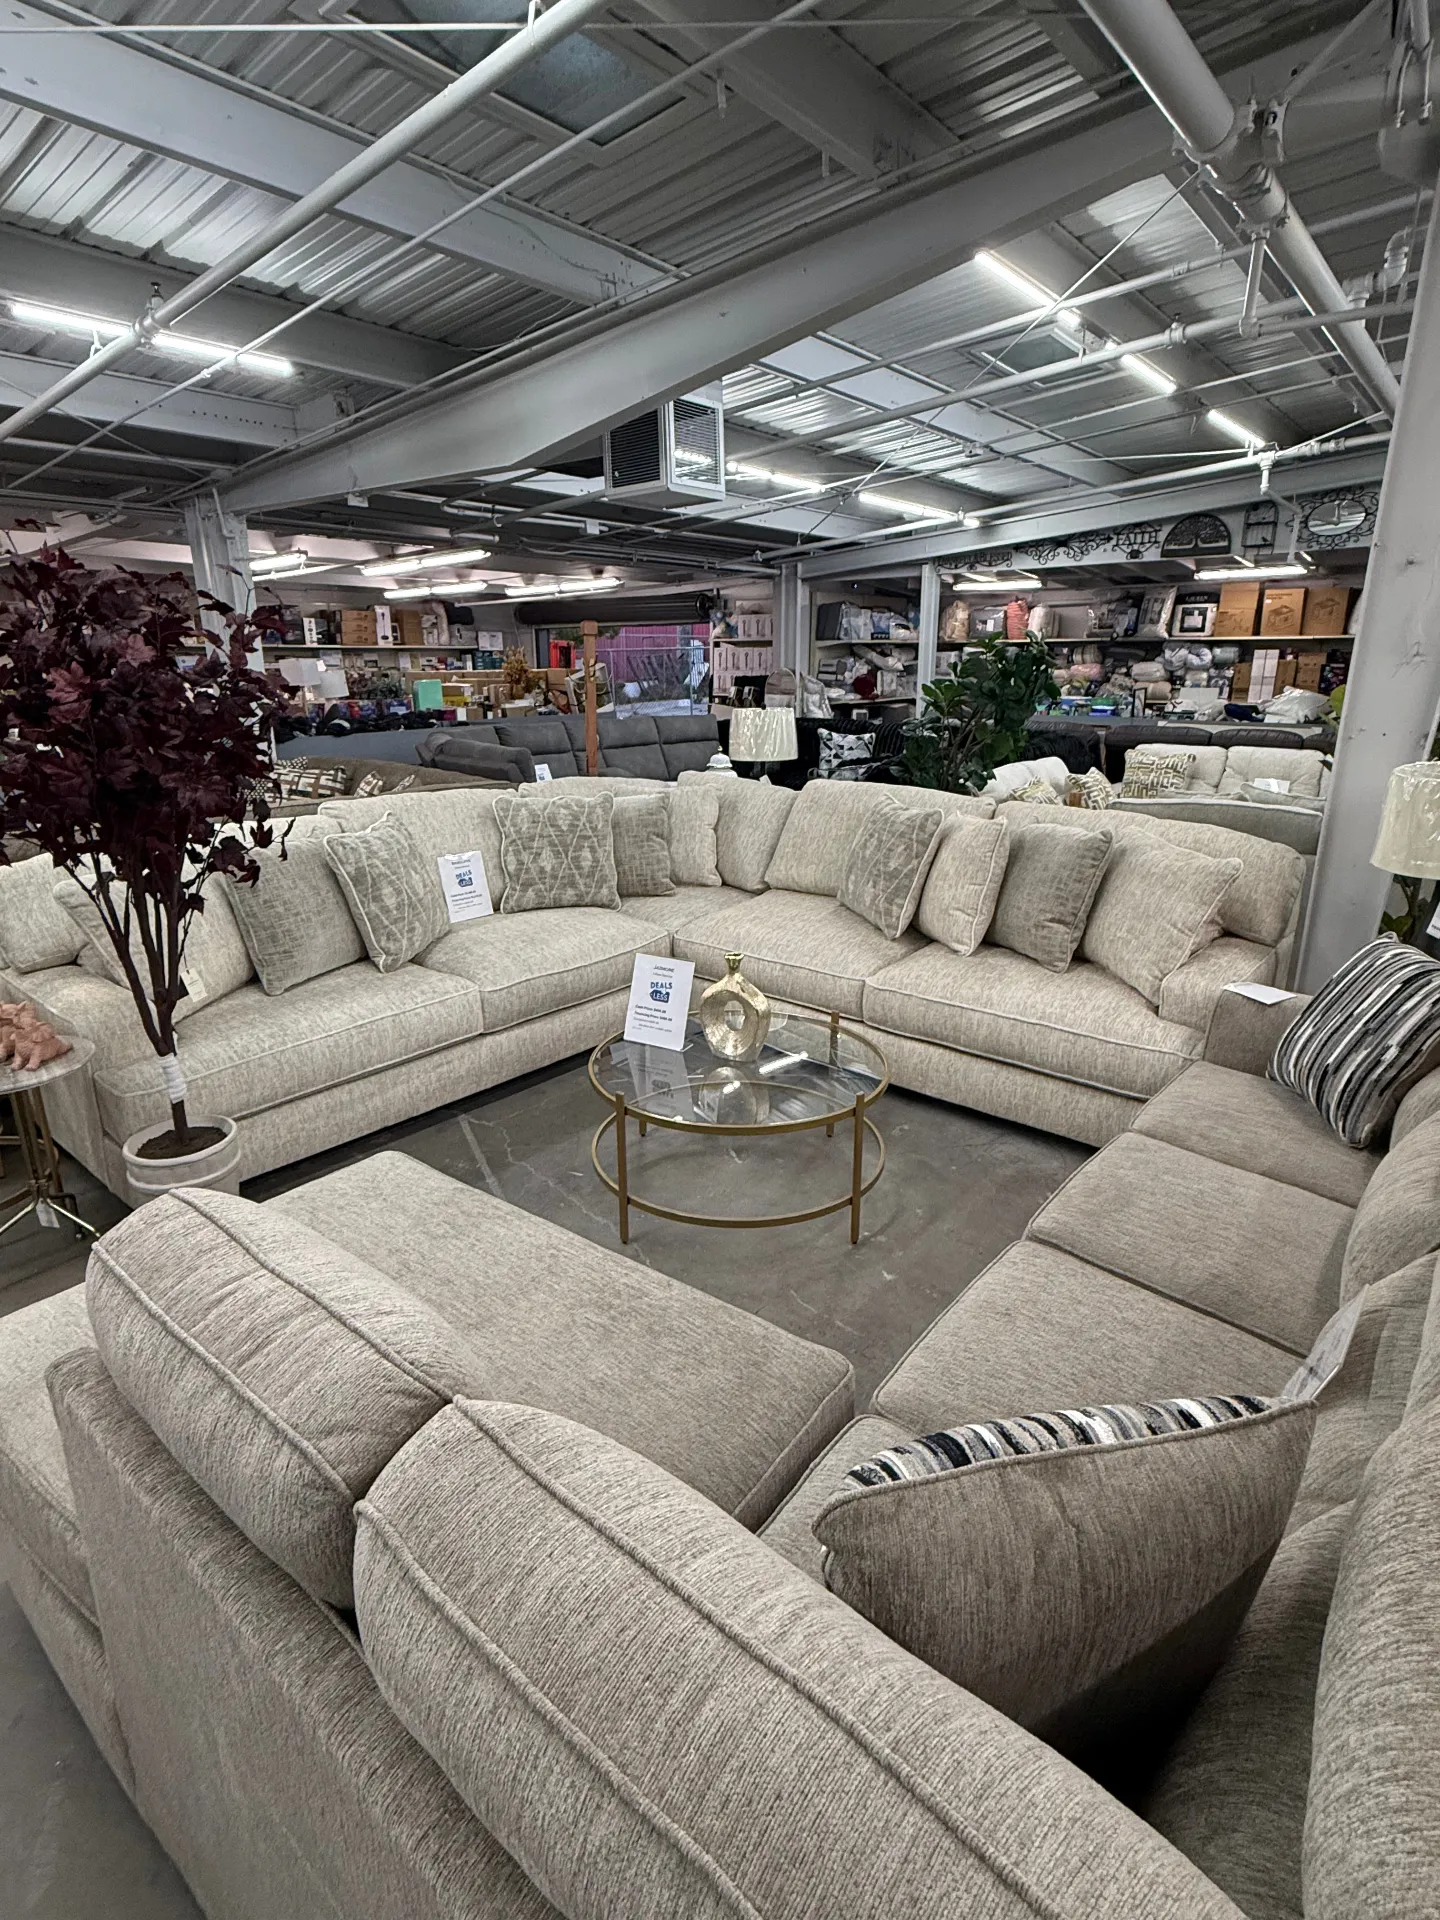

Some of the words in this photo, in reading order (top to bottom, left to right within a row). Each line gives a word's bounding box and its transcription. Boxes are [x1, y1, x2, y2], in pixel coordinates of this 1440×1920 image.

[1115, 530, 1159, 546] FAITH
[650, 981, 673, 990] DEALS
[653, 992, 668, 1001] LESS
